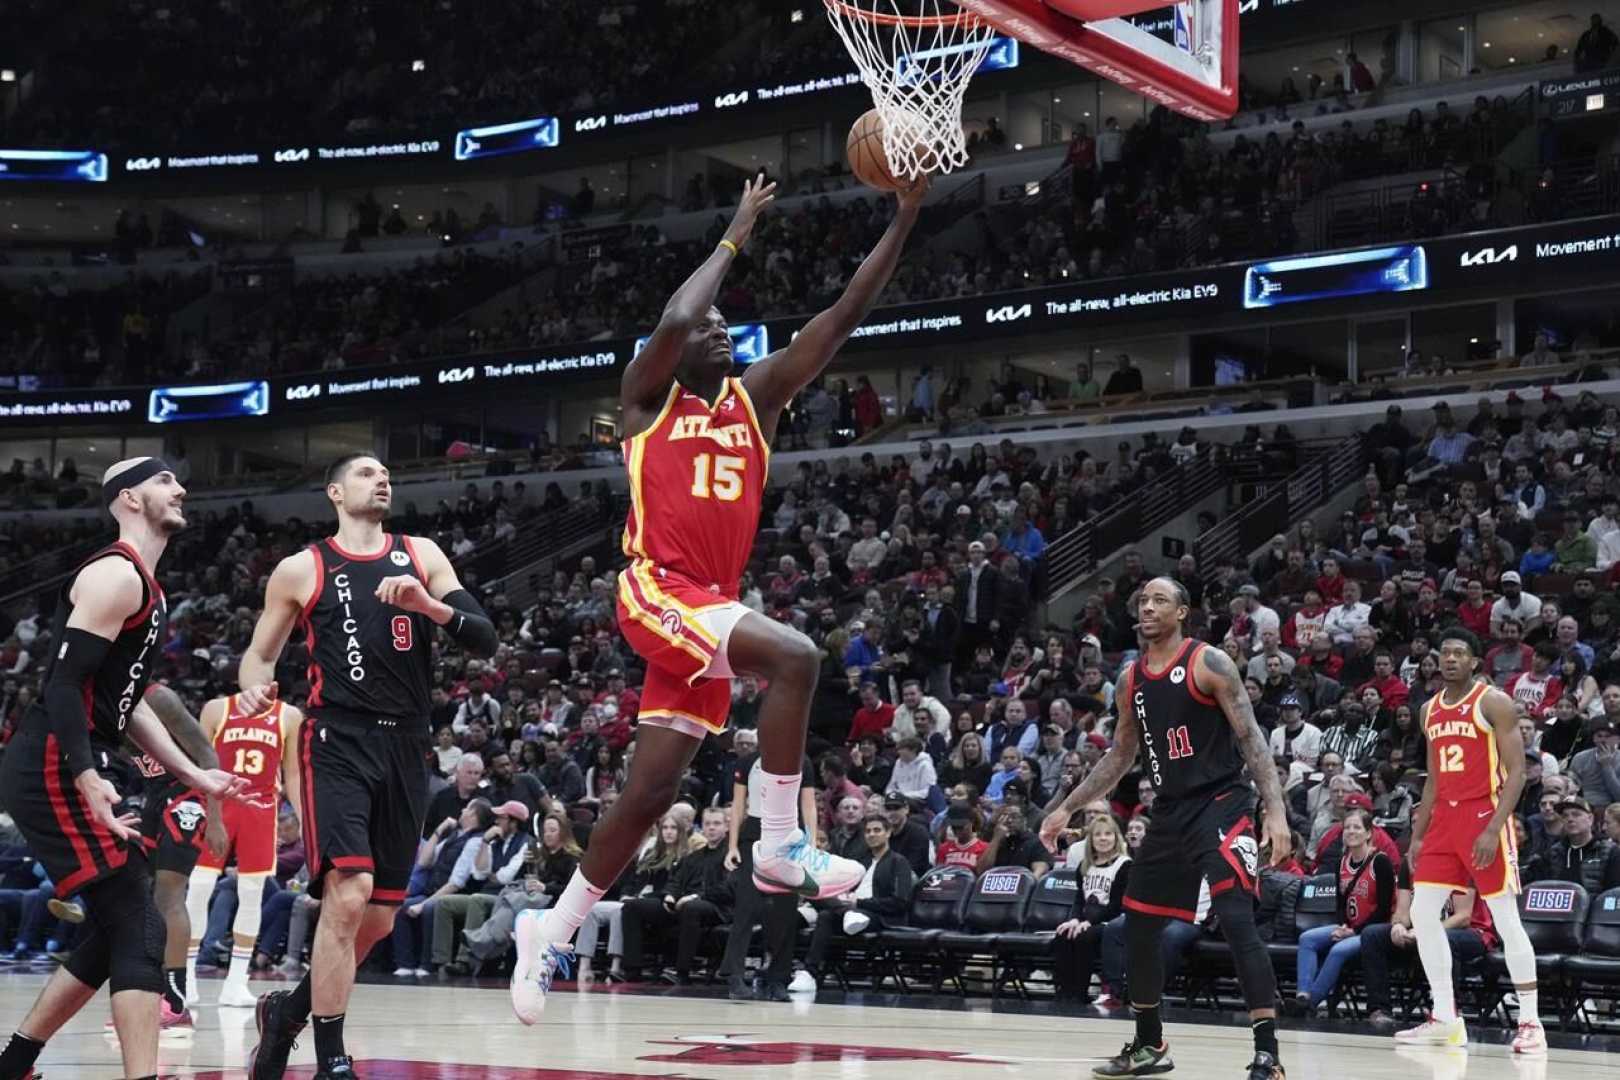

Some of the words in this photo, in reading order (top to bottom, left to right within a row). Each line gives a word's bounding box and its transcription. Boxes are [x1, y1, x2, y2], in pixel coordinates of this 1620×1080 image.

[1460, 244, 1518, 267] KIA
[1536, 235, 1611, 258] Movement
[985, 304, 1032, 323] KIA
[1046, 301, 1067, 315] The
[1113, 290, 1171, 308] all-electric
[1172, 286, 1192, 301] Kia
[1194, 283, 1219, 298] EV9
[853, 322, 898, 338] ovement
[900, 318, 921, 332] that
[922, 314, 963, 331] inspires
[596, 352, 616, 366] EV9
[691, 453, 747, 502] 15
[334, 573, 365, 682] CHICAGO
[391, 615, 412, 652] 9
[119, 609, 160, 731] CHICAGO
[223, 727, 278, 749] ATLANTA
[1134, 691, 1162, 786] CHICAGO
[1166, 725, 1194, 761] 11
[232, 748, 264, 775] 13
[1439, 744, 1465, 773] 12
[991, 876, 1012, 892] USO
[1536, 891, 1564, 909] USO
